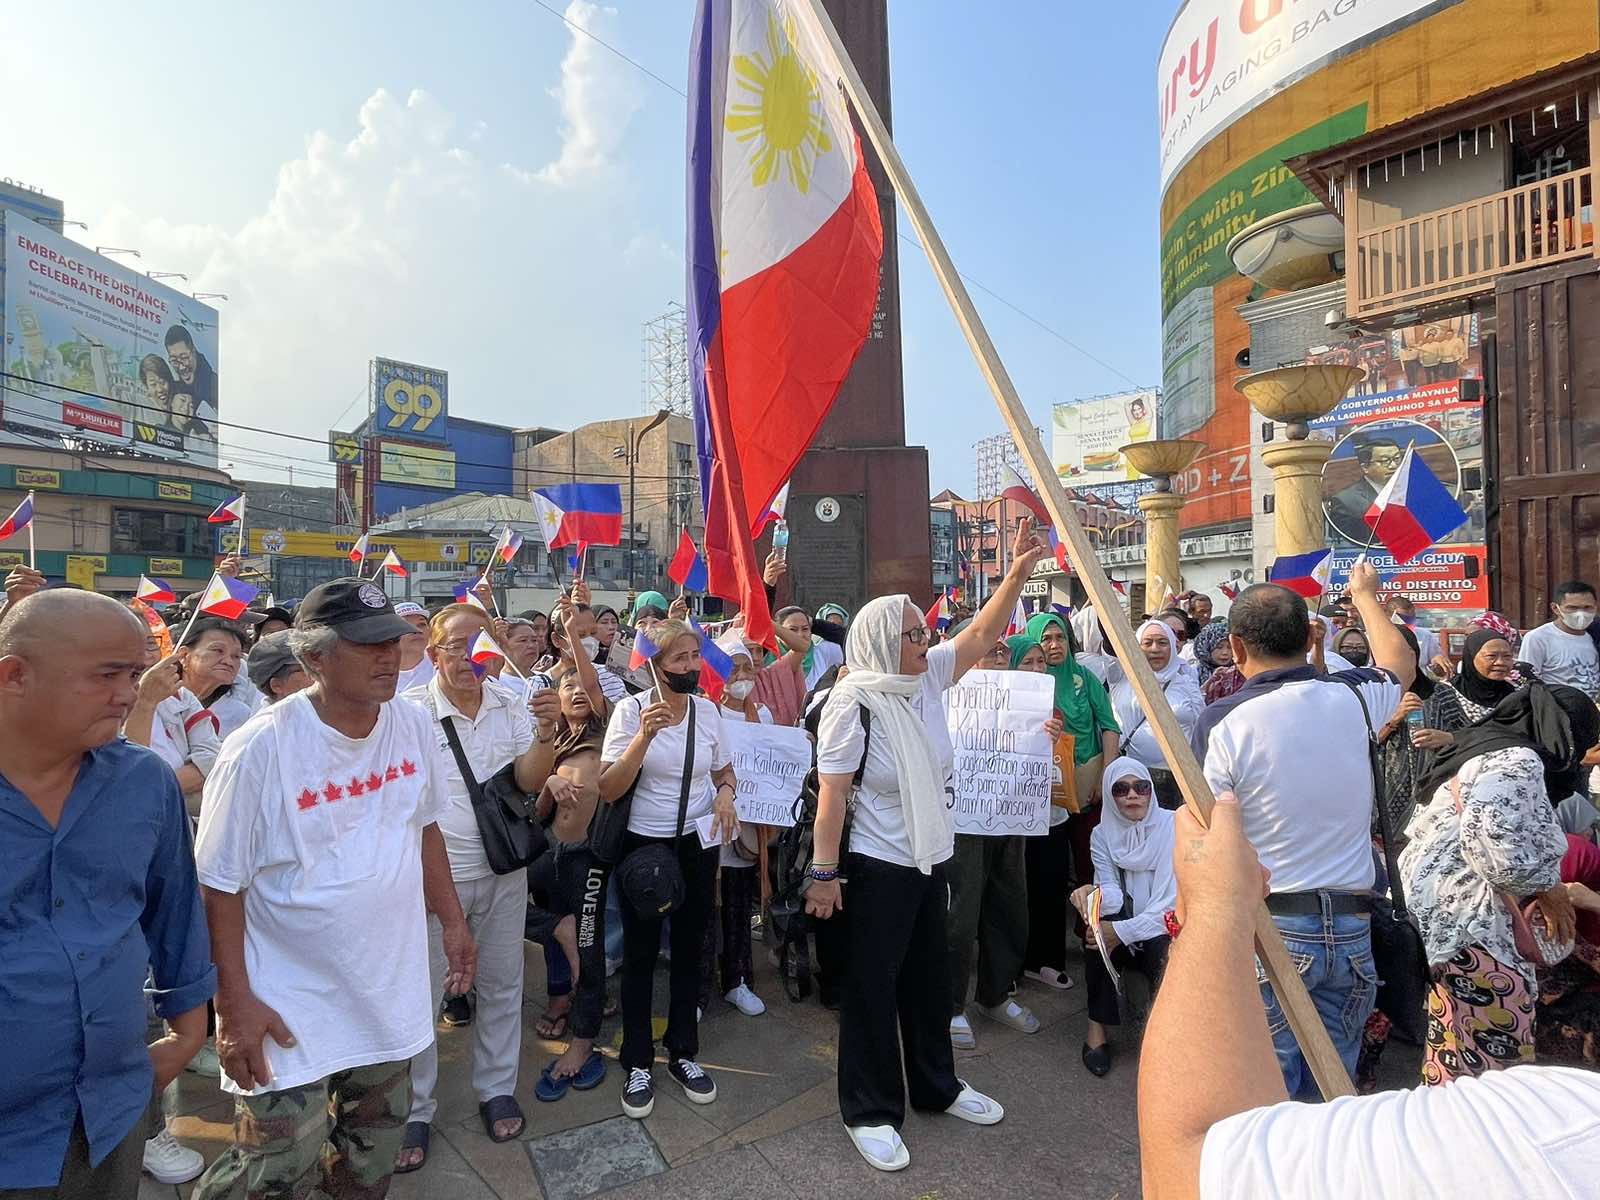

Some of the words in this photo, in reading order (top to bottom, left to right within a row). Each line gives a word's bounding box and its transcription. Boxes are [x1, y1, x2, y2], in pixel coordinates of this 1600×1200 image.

[1200, 39, 1282, 112] LAGING
[1200, 189, 1244, 229] with
[1251, 166, 1297, 198] Zin
[1175, 208, 1257, 277] immunity
[17, 235, 85, 275] EMBRACE
[86, 266, 110, 286] THE
[111, 277, 169, 314] DISTANCE,
[28, 259, 102, 300] CELEBRATE
[104, 291, 161, 325] MOMENTS
[383, 378, 442, 432] 99
[1312, 415, 1336, 425] KAYA
[1337, 408, 1373, 421] LAGING
[1374, 402, 1425, 416] SUMUNOD
[1427, 399, 1442, 408] SA
[1443, 396, 1459, 406] BA
[1341, 396, 1394, 410] GOBYERNO
[1396, 393, 1410, 402] SA
[1412, 385, 1459, 400] MAYNILA
[156, 436, 176, 447] Union
[335, 439, 359, 461] 99
[1169, 467, 1202, 495] CID
[266, 544, 281, 552] TNT
[1332, 557, 1357, 569] TTY
[1423, 553, 1466, 566] CHUA
[1024, 582, 1047, 594] ULIS
[1382, 581, 1401, 590] NG
[1406, 579, 1477, 591] DISTRITO,
[748, 799, 793, 824] FREEDOM
[583, 868, 604, 913] LOVE
